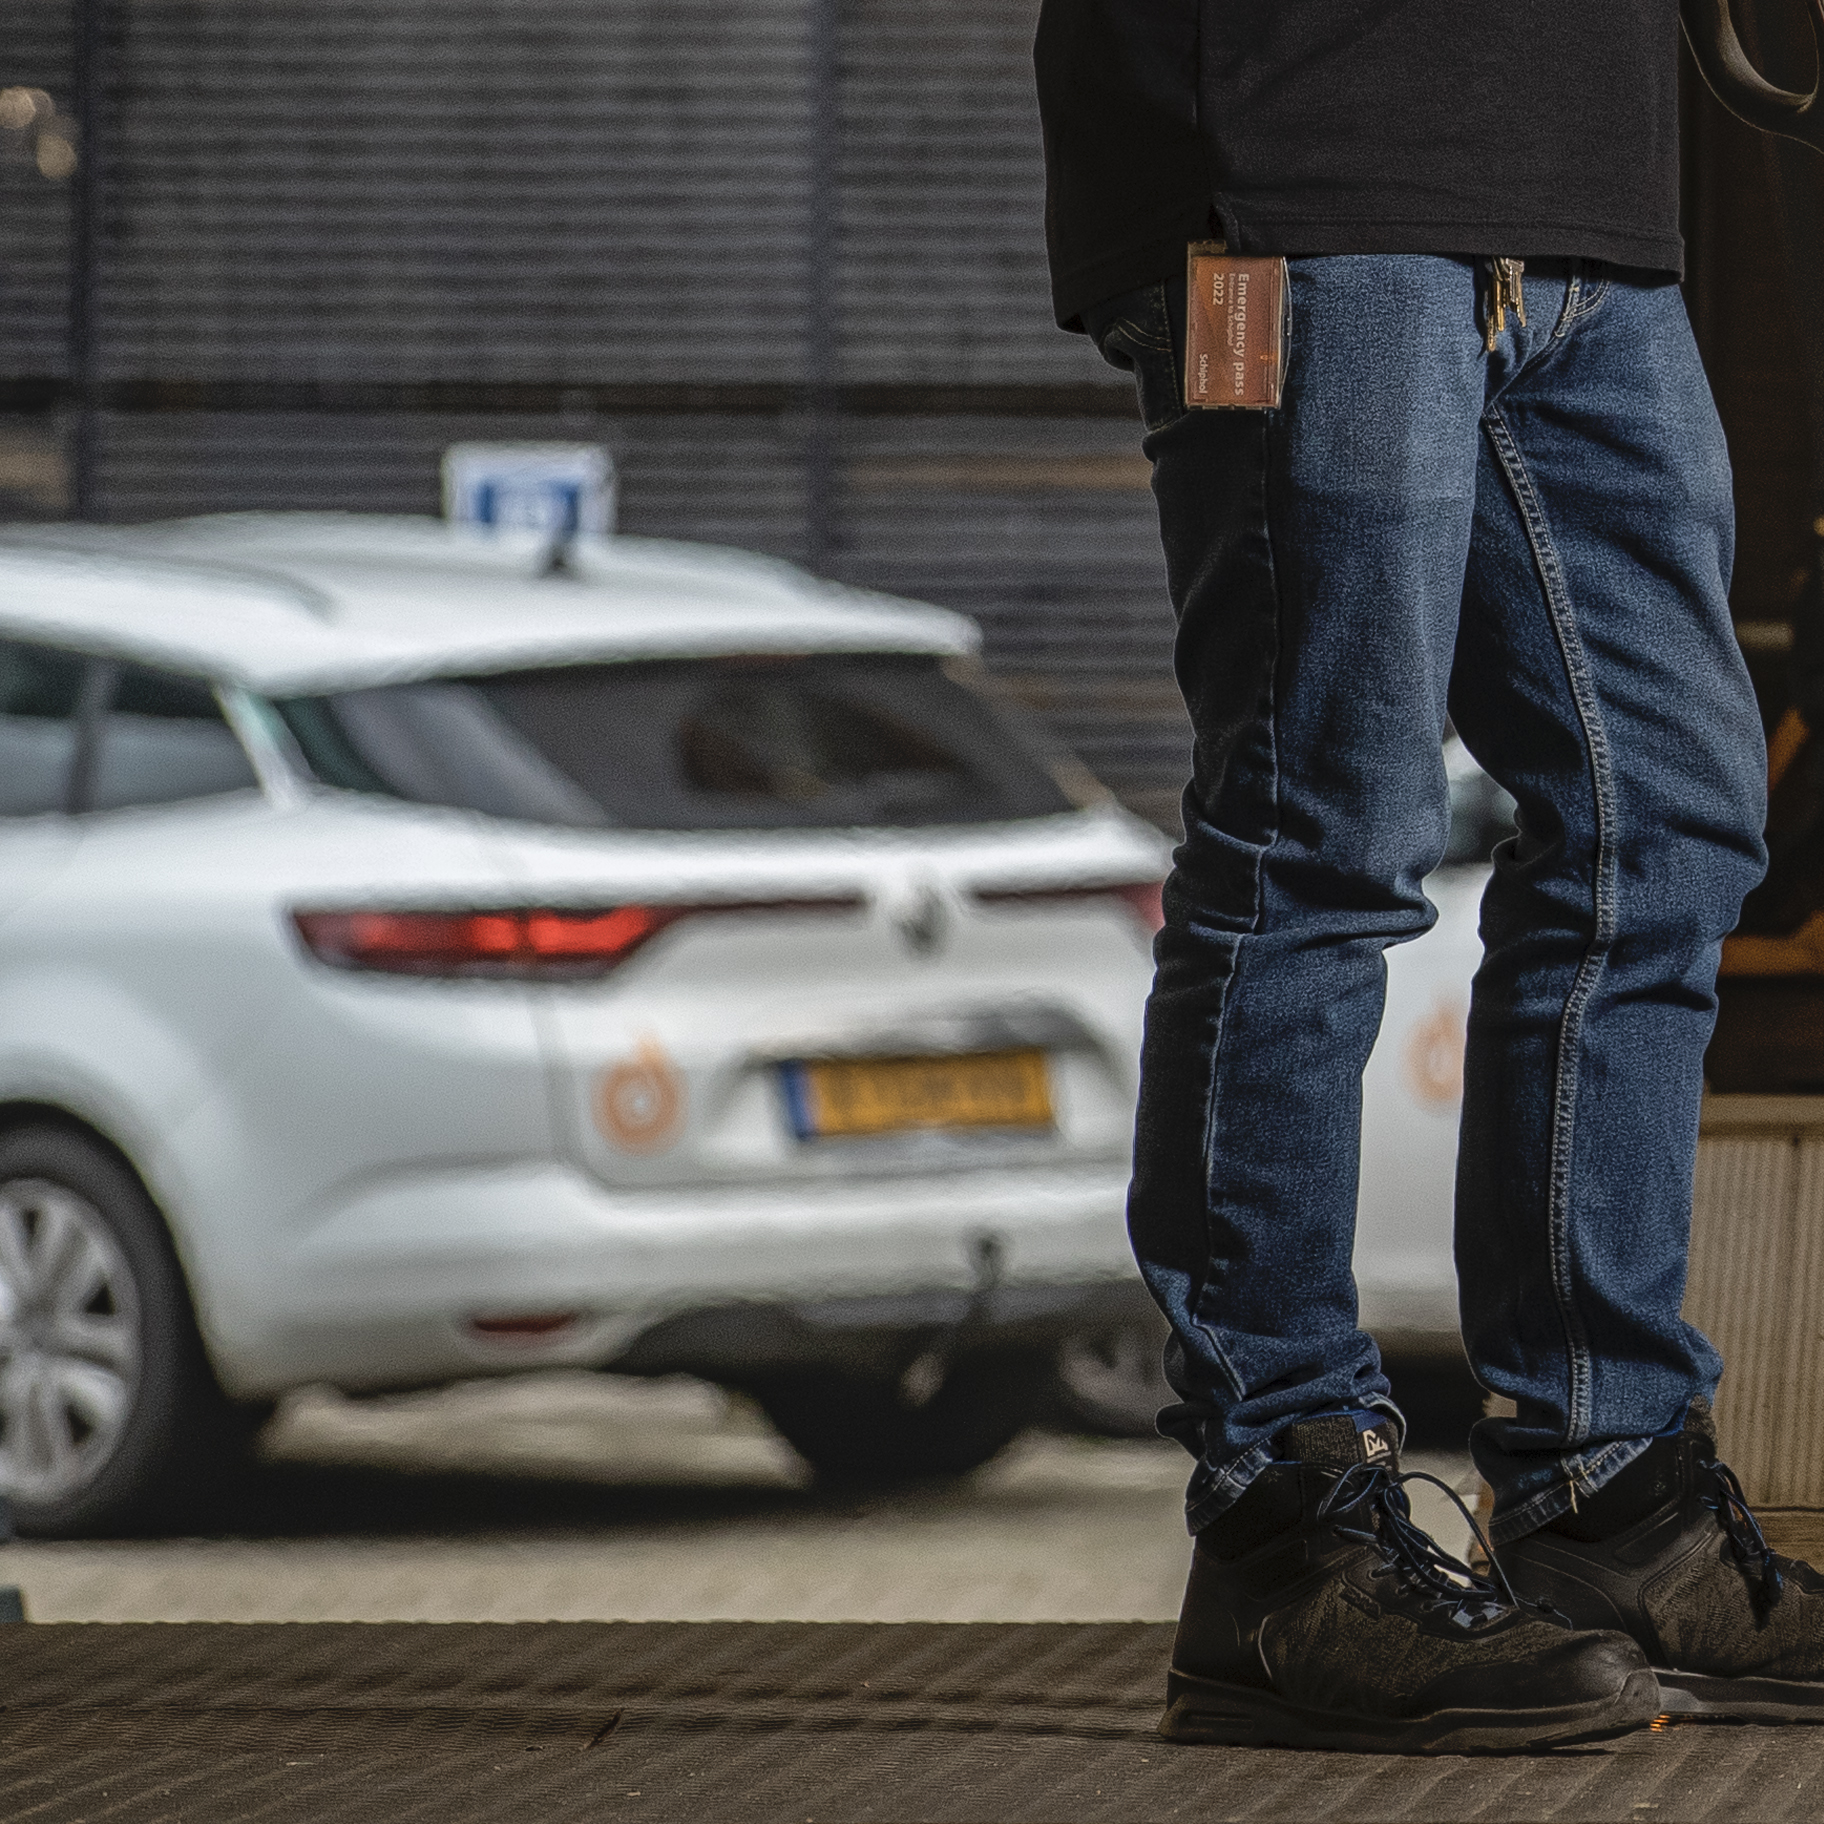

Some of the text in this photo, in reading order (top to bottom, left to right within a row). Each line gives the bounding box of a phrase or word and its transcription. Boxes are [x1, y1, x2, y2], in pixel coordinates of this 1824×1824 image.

[1212, 272, 1225, 306] 2022
[1232, 273, 1250, 396] Emergency pass
[1198, 353, 1209, 394] Schiphol
